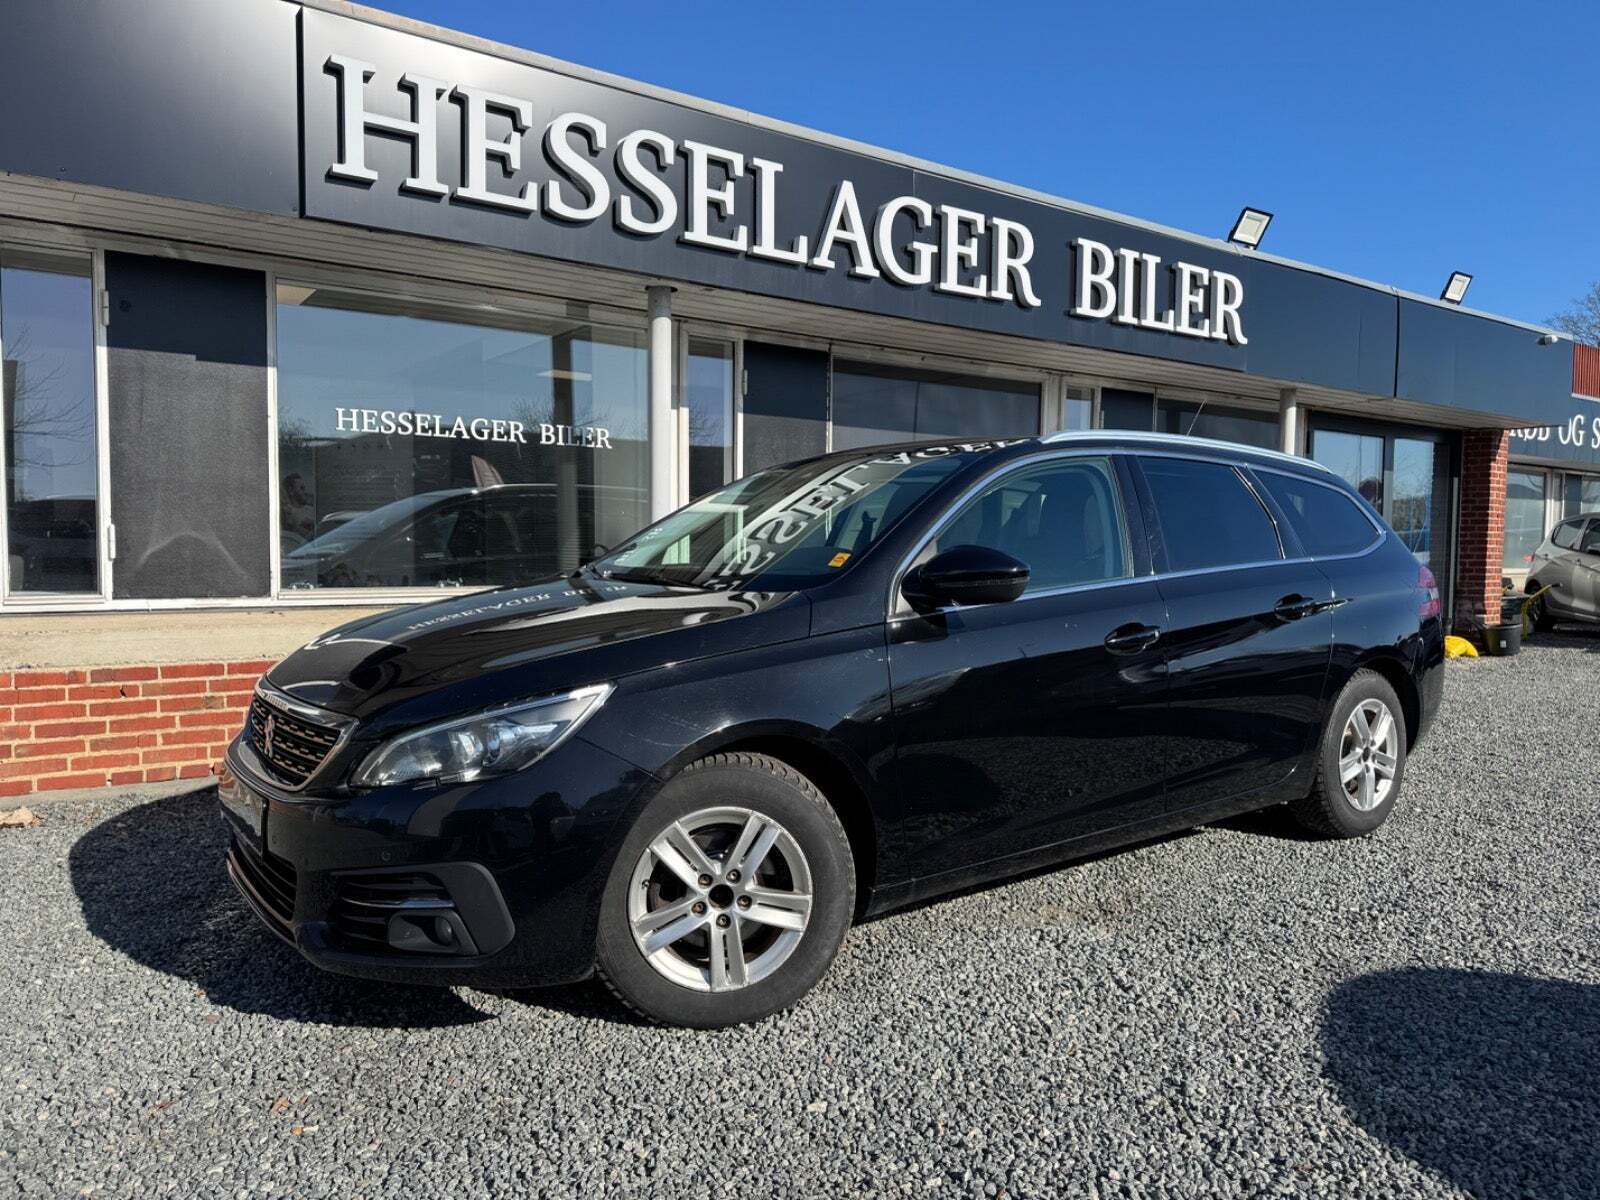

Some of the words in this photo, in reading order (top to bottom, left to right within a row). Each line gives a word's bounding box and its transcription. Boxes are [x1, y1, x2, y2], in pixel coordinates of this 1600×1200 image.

[324, 54, 1041, 308] HESSELAGER
[1072, 237, 1248, 345] BILER
[335, 407, 527, 443] HESSELAGER
[539, 423, 613, 449] BILER
